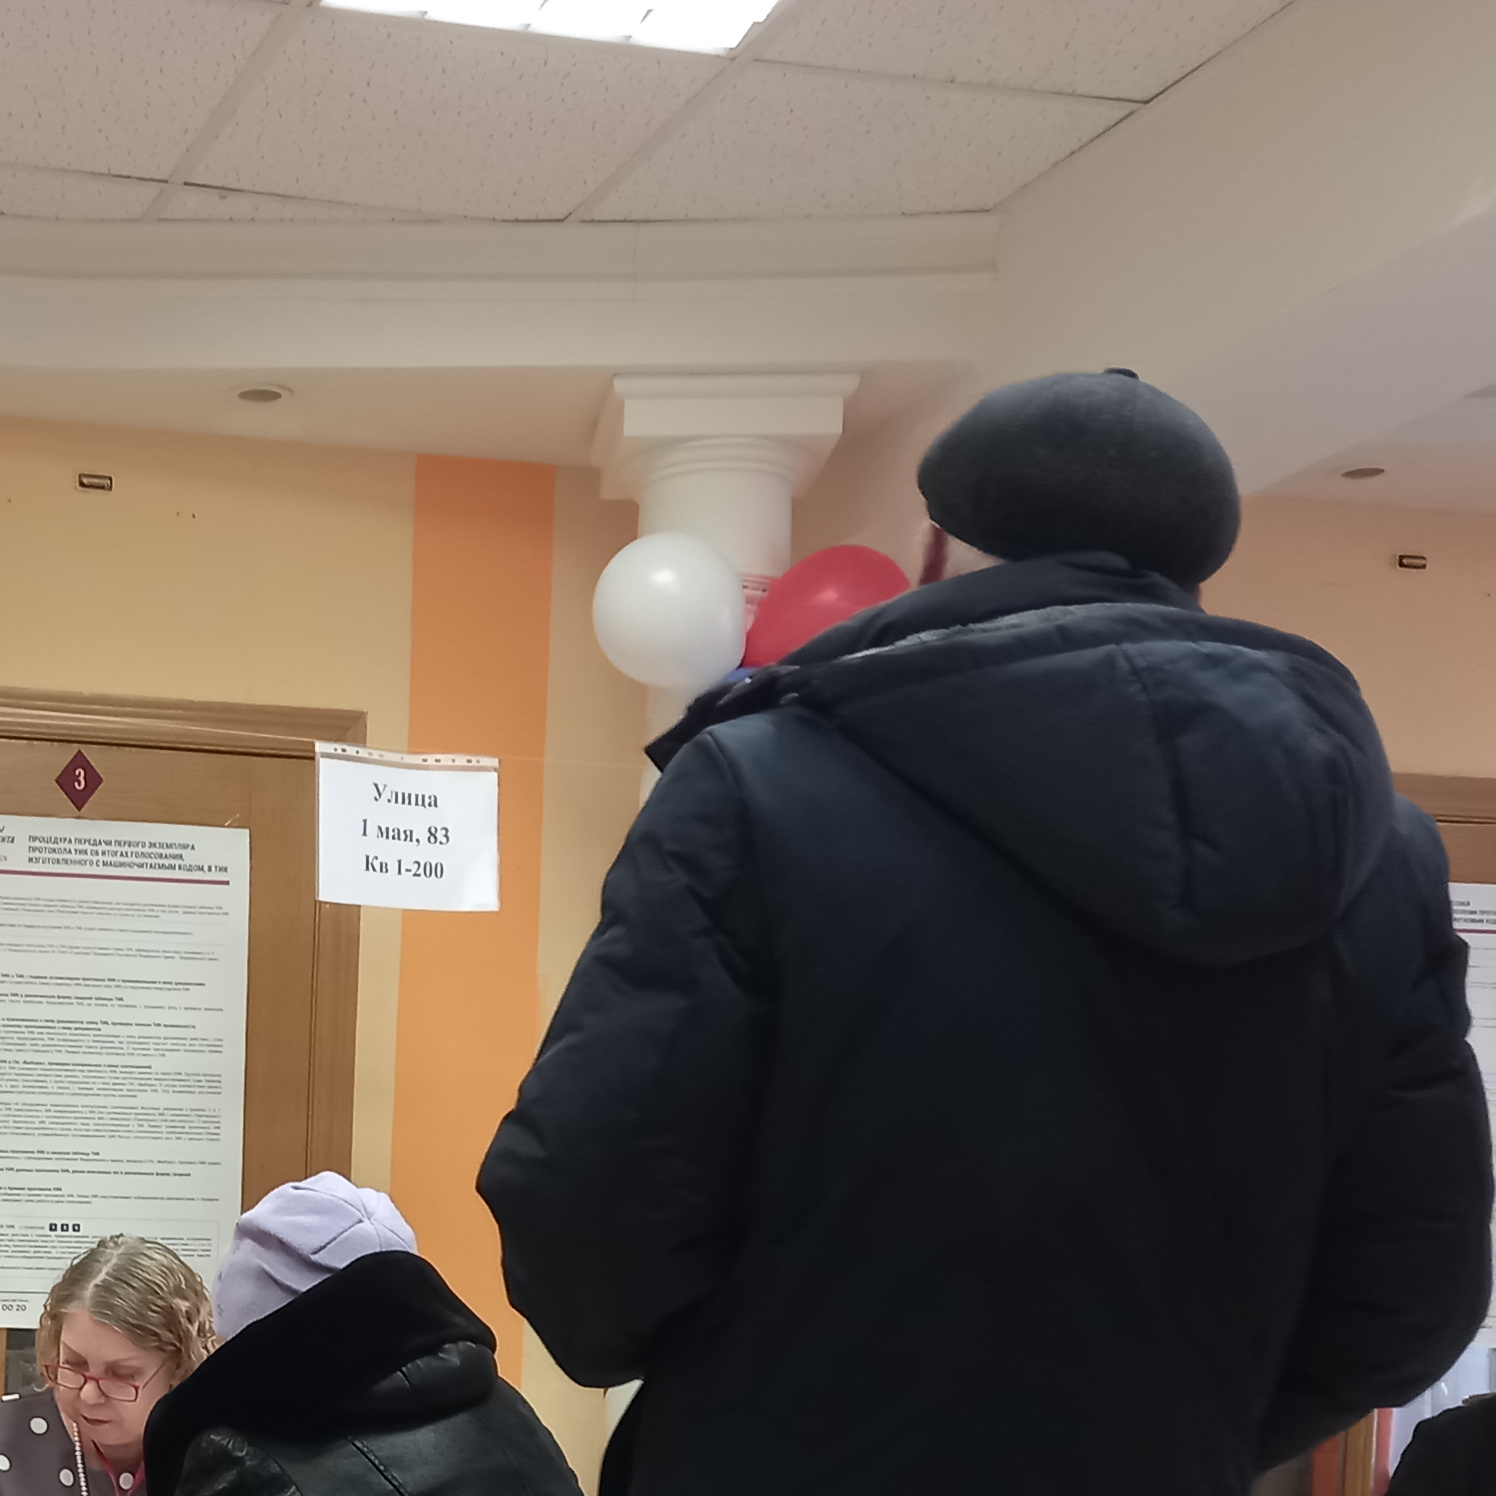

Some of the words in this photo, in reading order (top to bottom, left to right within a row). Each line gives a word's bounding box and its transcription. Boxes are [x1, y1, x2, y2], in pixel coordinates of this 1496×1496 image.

[74, 768, 85, 790] 3
[372, 782, 439, 809] Улица
[361, 818, 368, 837] 1
[376, 825, 421, 847] мая,
[427, 826, 450, 846] 83
[28, 835, 73, 845] ПРОЦЕДУРА
[74, 838, 113, 847] ПЕРЕДАЧИ
[114, 839, 146, 848] ПЕРВОГО
[148, 841, 196, 851] ЭКЗЕМПЛЯРА
[28, 845, 72, 855] ПРОТОКОЛА
[74, 848, 88, 856] УИК
[101, 850, 129, 858] ИТОГАХ
[28, 857, 94, 867] ИЗГОТОВЛЕННОГО
[364, 854, 389, 874] Кв
[396, 858, 444, 880] 1-200
[15, 1304, 26, 1312] 20
